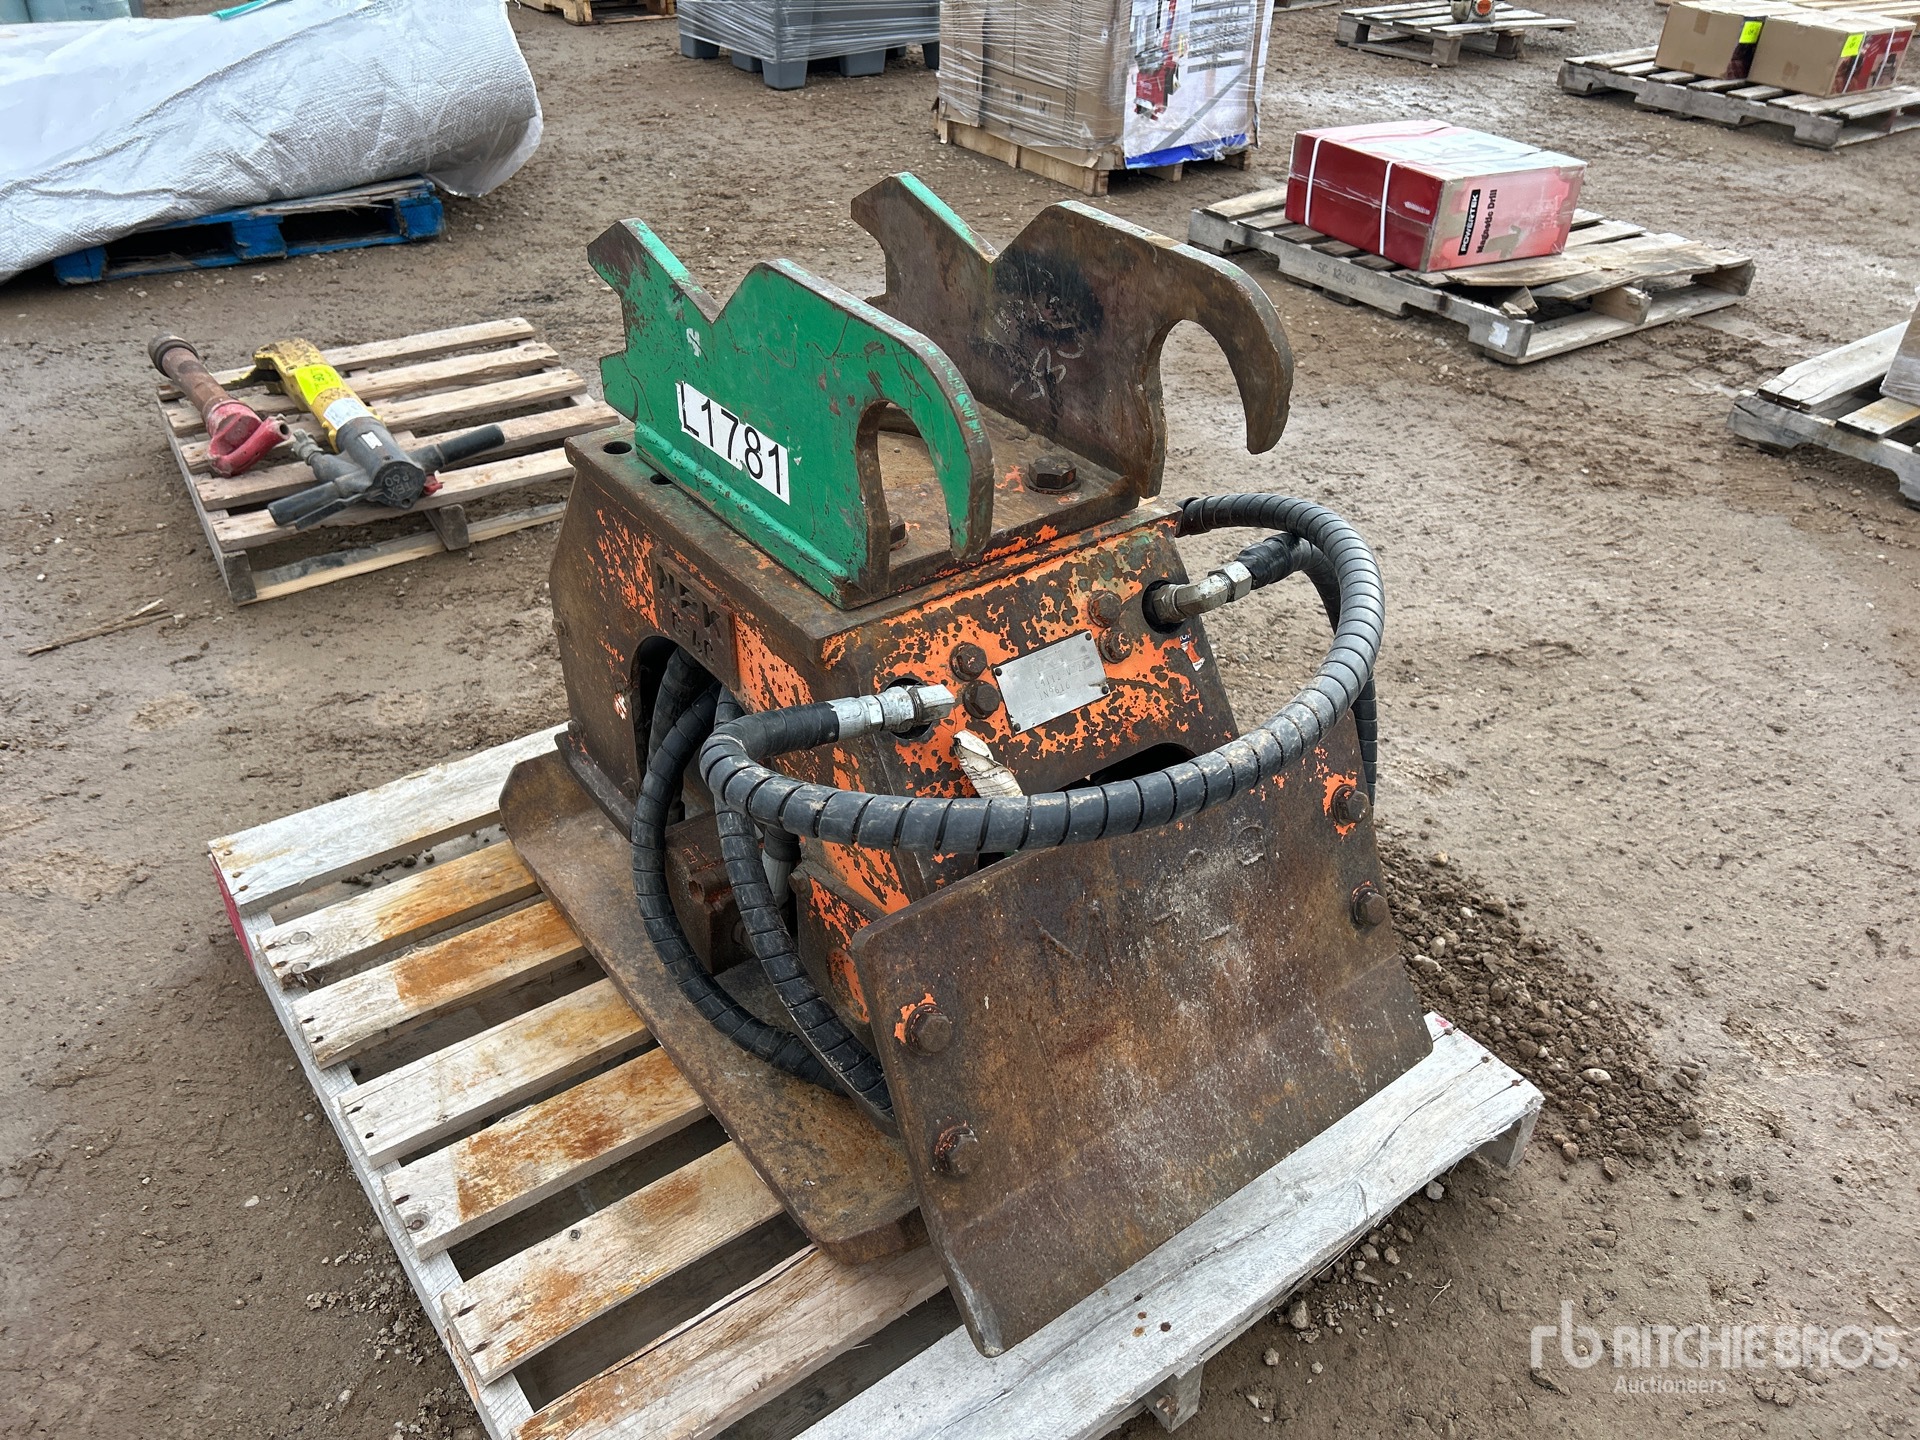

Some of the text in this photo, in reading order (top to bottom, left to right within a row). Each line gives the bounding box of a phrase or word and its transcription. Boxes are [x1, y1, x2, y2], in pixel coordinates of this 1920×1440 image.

[1461, 194, 1478, 252] POWERTEK
[1476, 189, 1497, 253] Magnetic Drill
[680, 382, 781, 496] L1781
